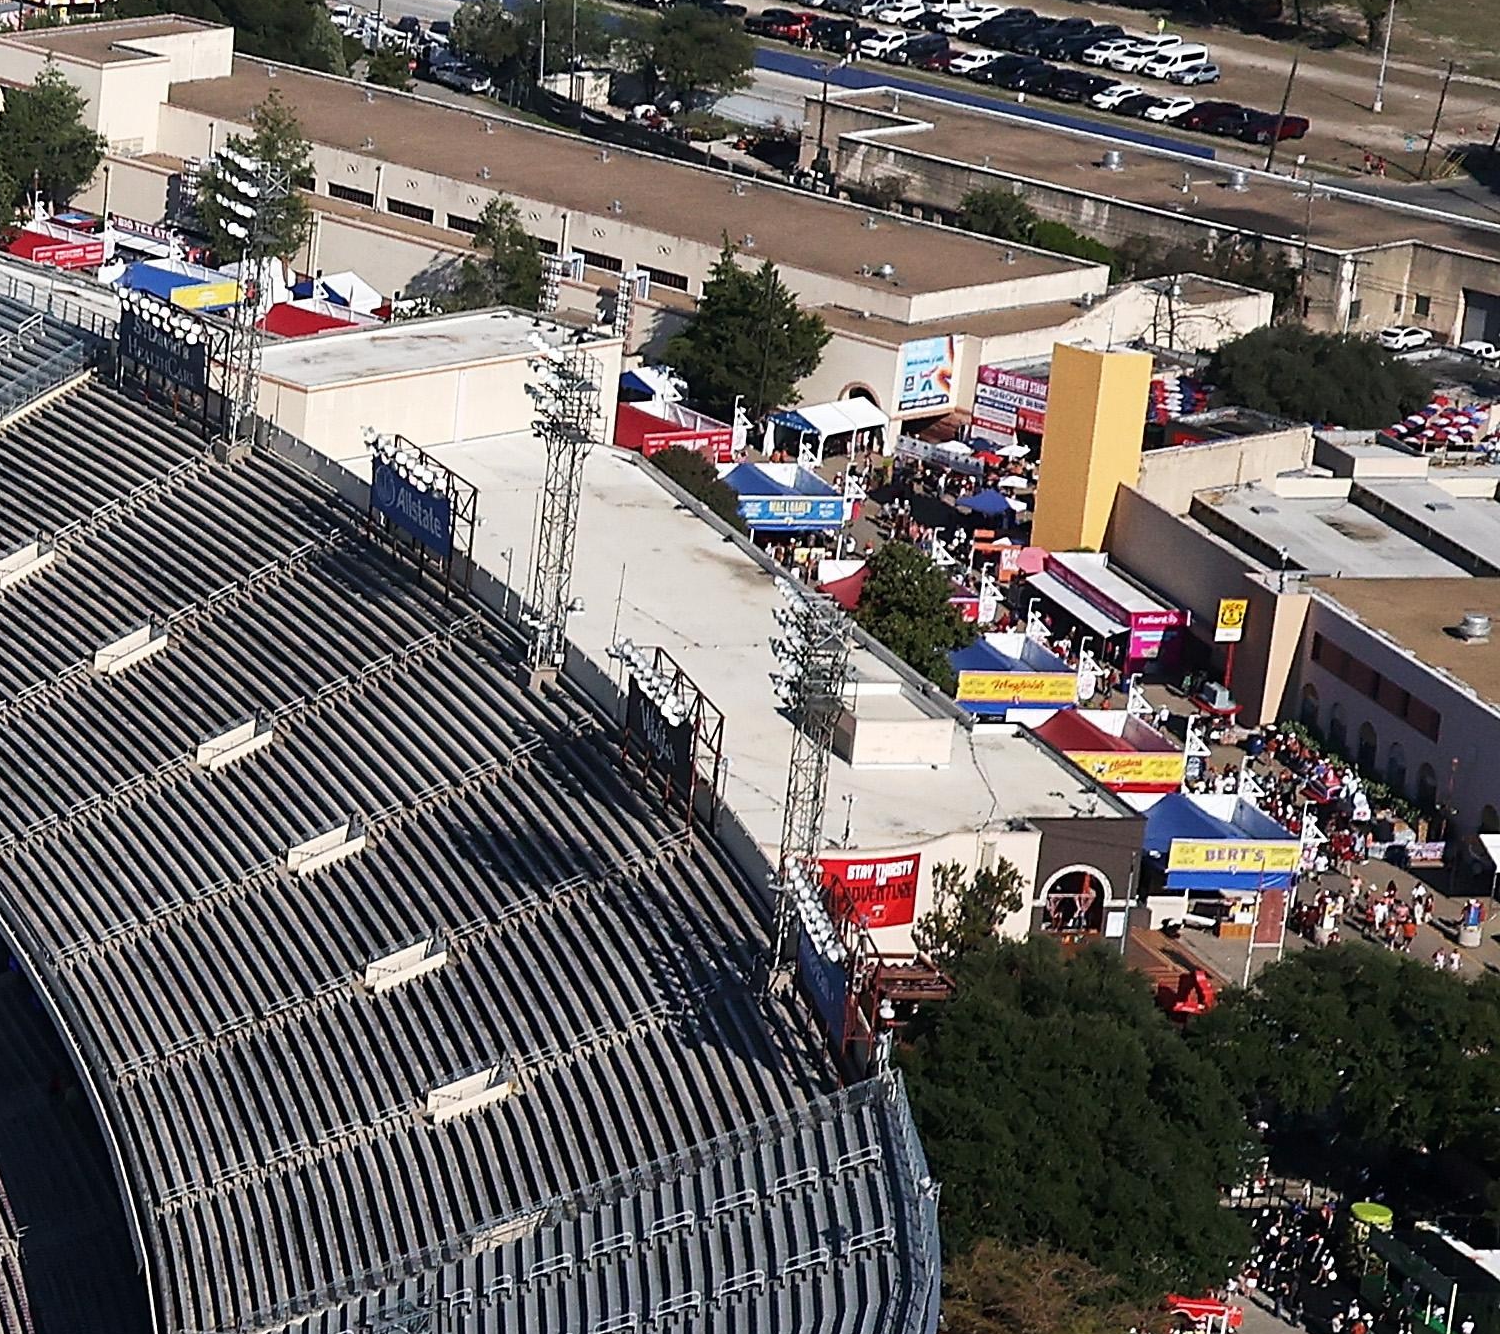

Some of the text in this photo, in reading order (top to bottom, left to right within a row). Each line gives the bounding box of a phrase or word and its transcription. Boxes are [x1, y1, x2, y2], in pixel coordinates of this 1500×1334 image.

[397, 487, 442, 539] Allstate
[1138, 614, 1169, 625] reliant
[1204, 846, 1264, 862] BERT'S
[847, 860, 914, 880] STAY THIRSTY
